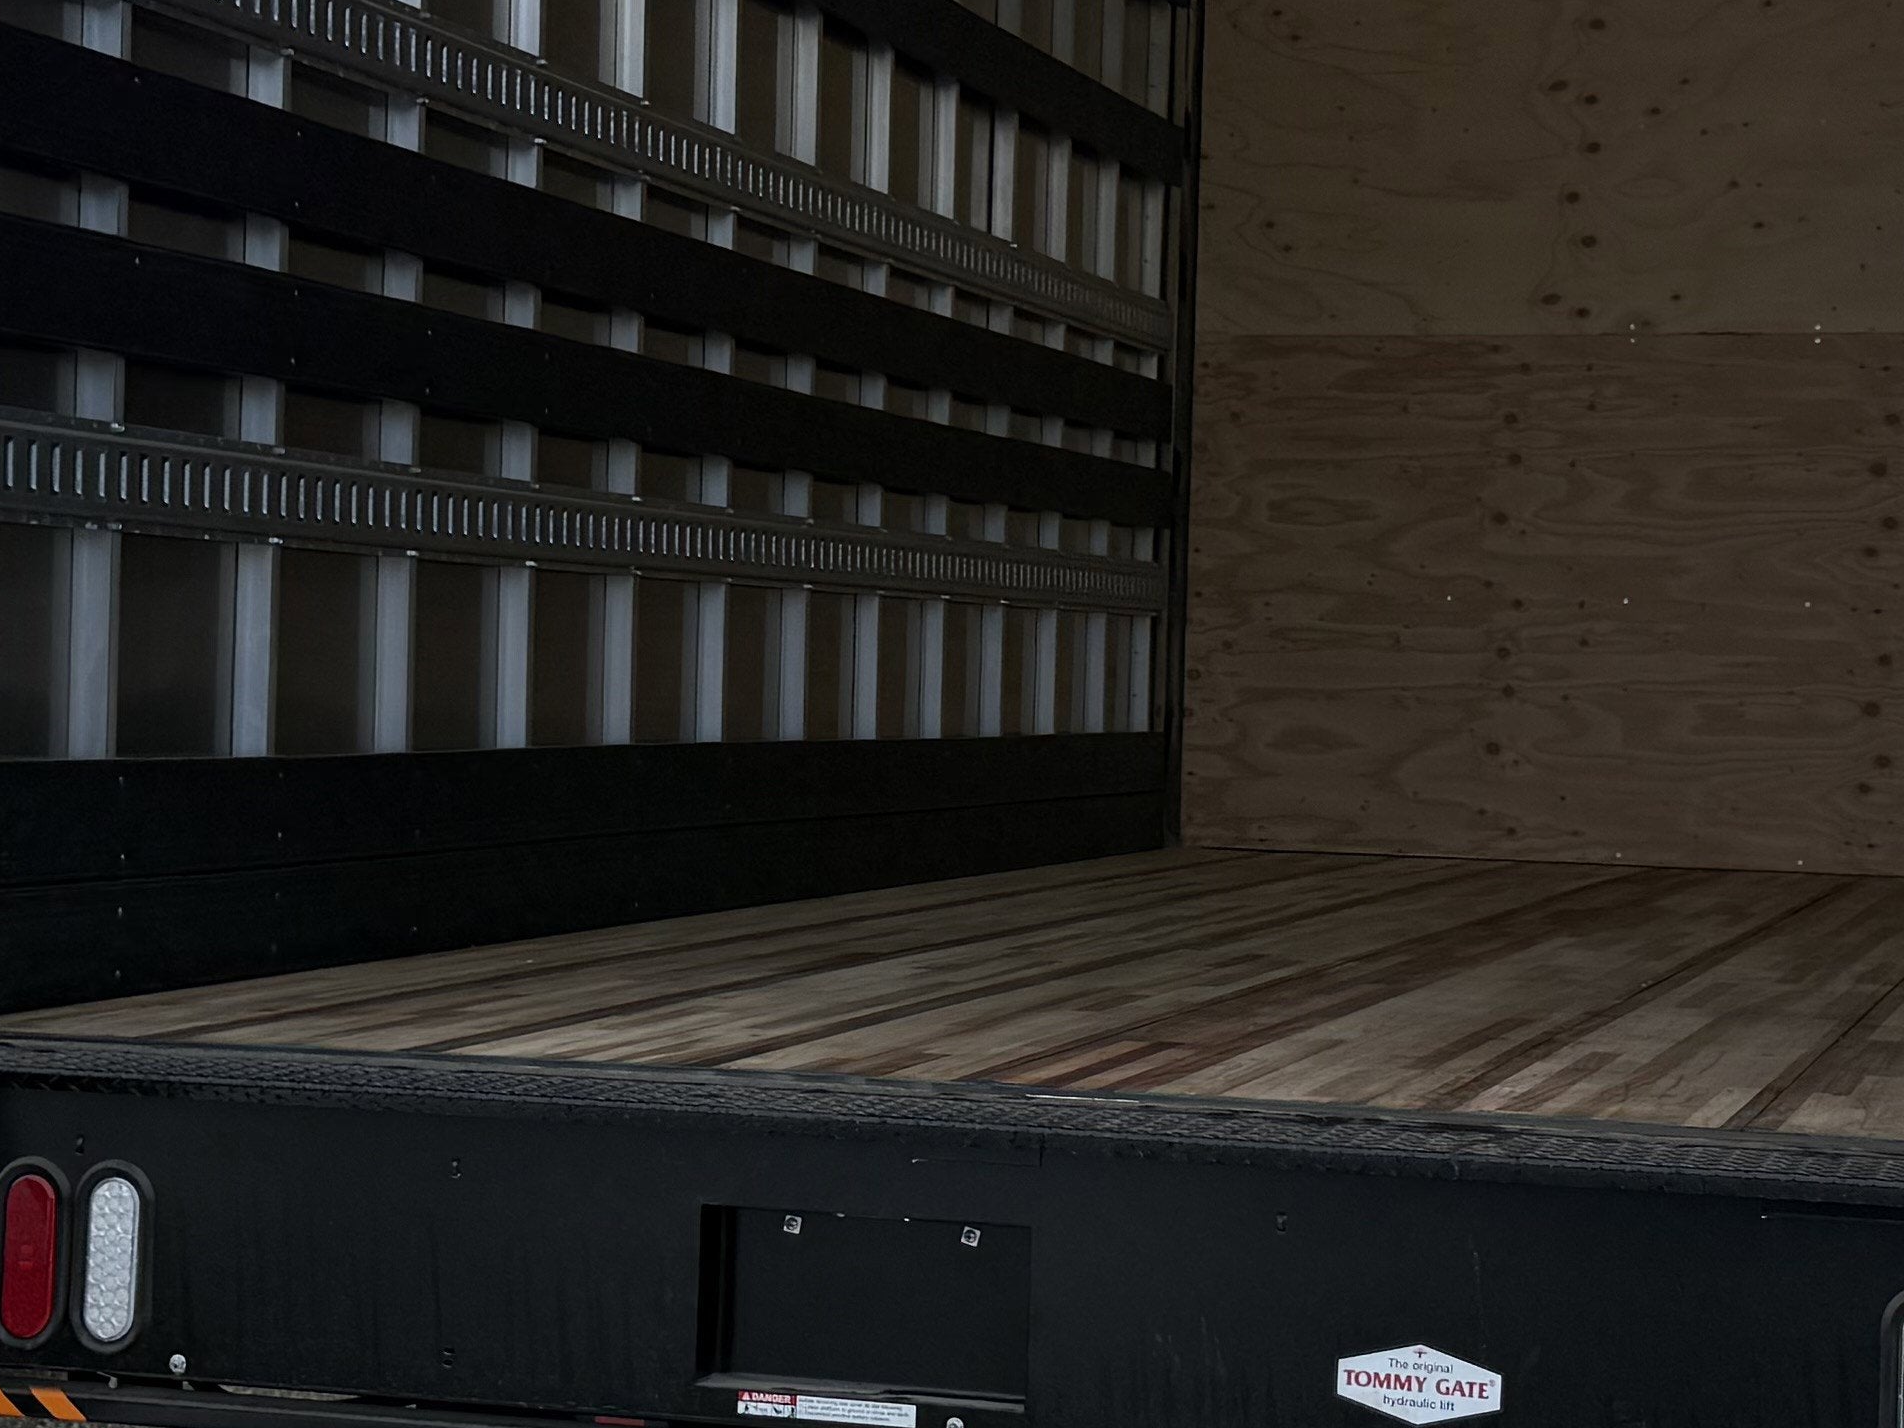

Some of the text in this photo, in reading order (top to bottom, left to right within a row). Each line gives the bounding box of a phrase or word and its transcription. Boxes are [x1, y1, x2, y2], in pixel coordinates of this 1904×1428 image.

[1388, 1357, 1453, 1374] The original
[1343, 1369, 1428, 1393] TOMMY
[751, 1392, 791, 1404] DANGER
[1383, 1394, 1455, 1412] hydraulic lift
